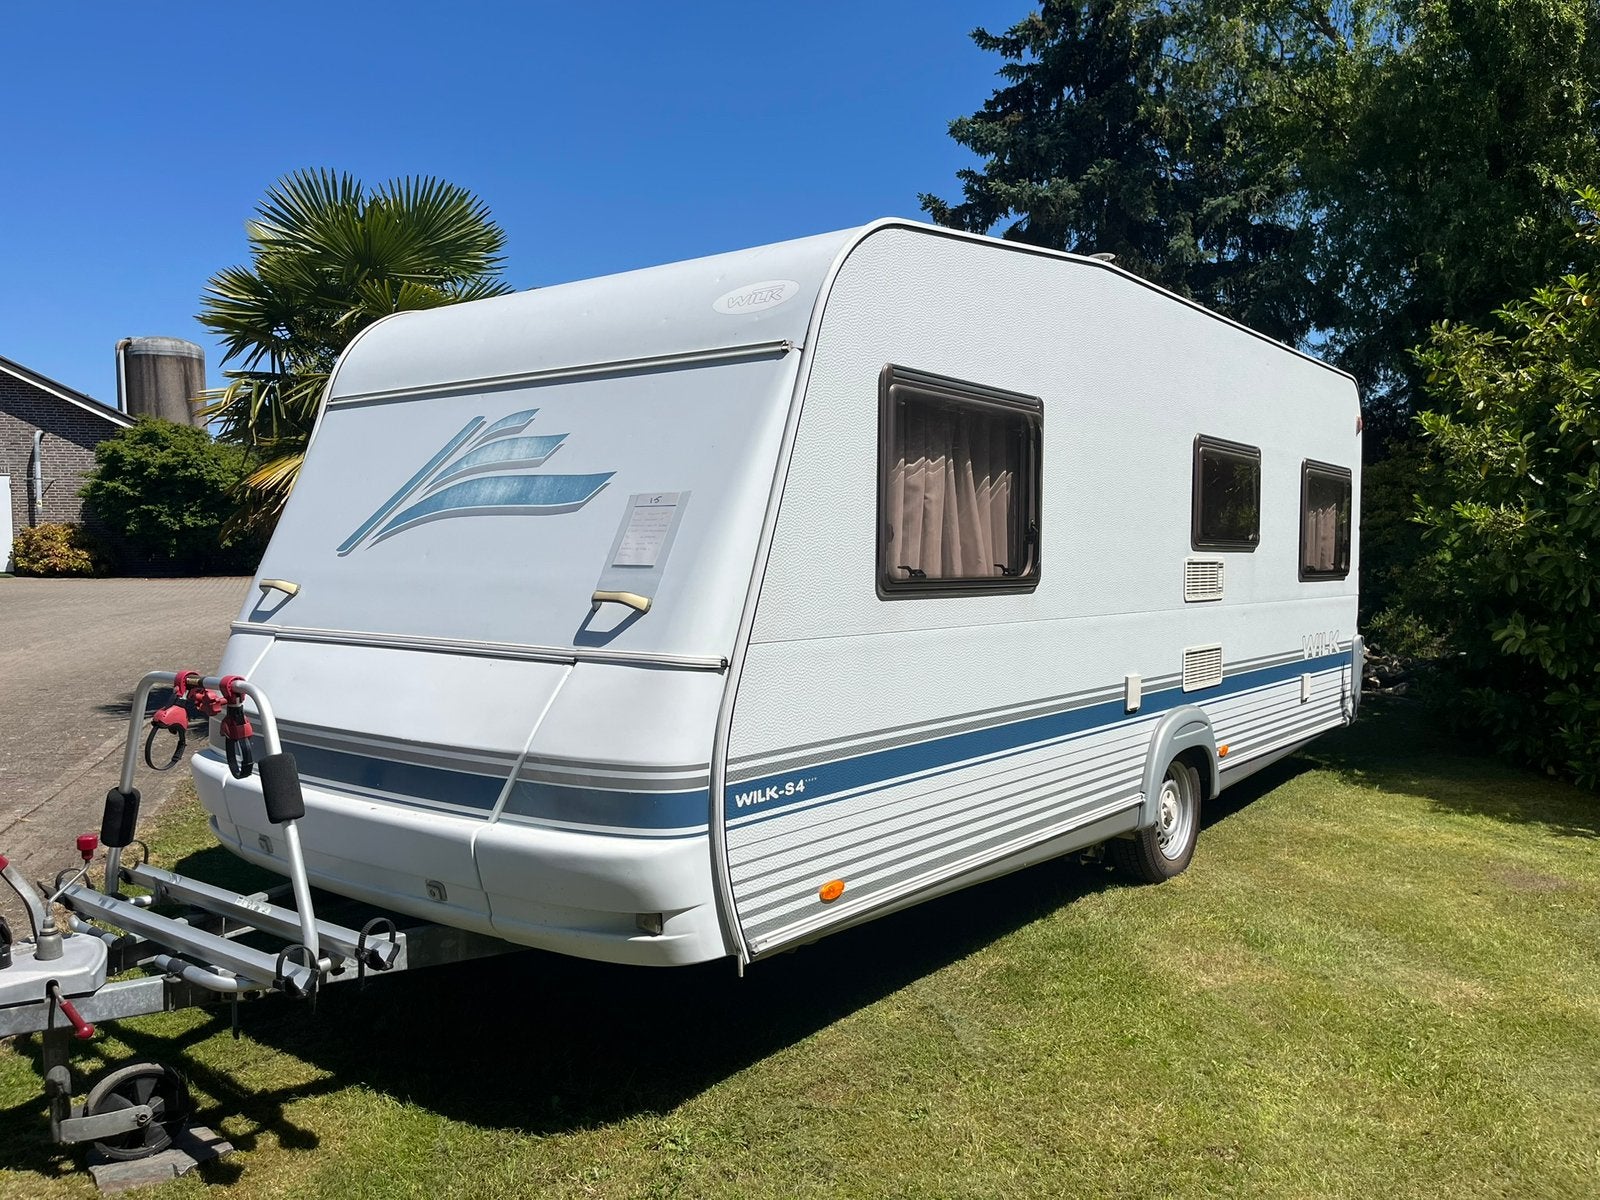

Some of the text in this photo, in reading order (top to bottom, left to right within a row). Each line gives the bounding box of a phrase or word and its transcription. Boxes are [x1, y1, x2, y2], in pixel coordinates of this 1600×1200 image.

[728, 284, 786, 309] WILK
[1302, 629, 1341, 660] WILK
[735, 779, 805, 808] WILK-S4
